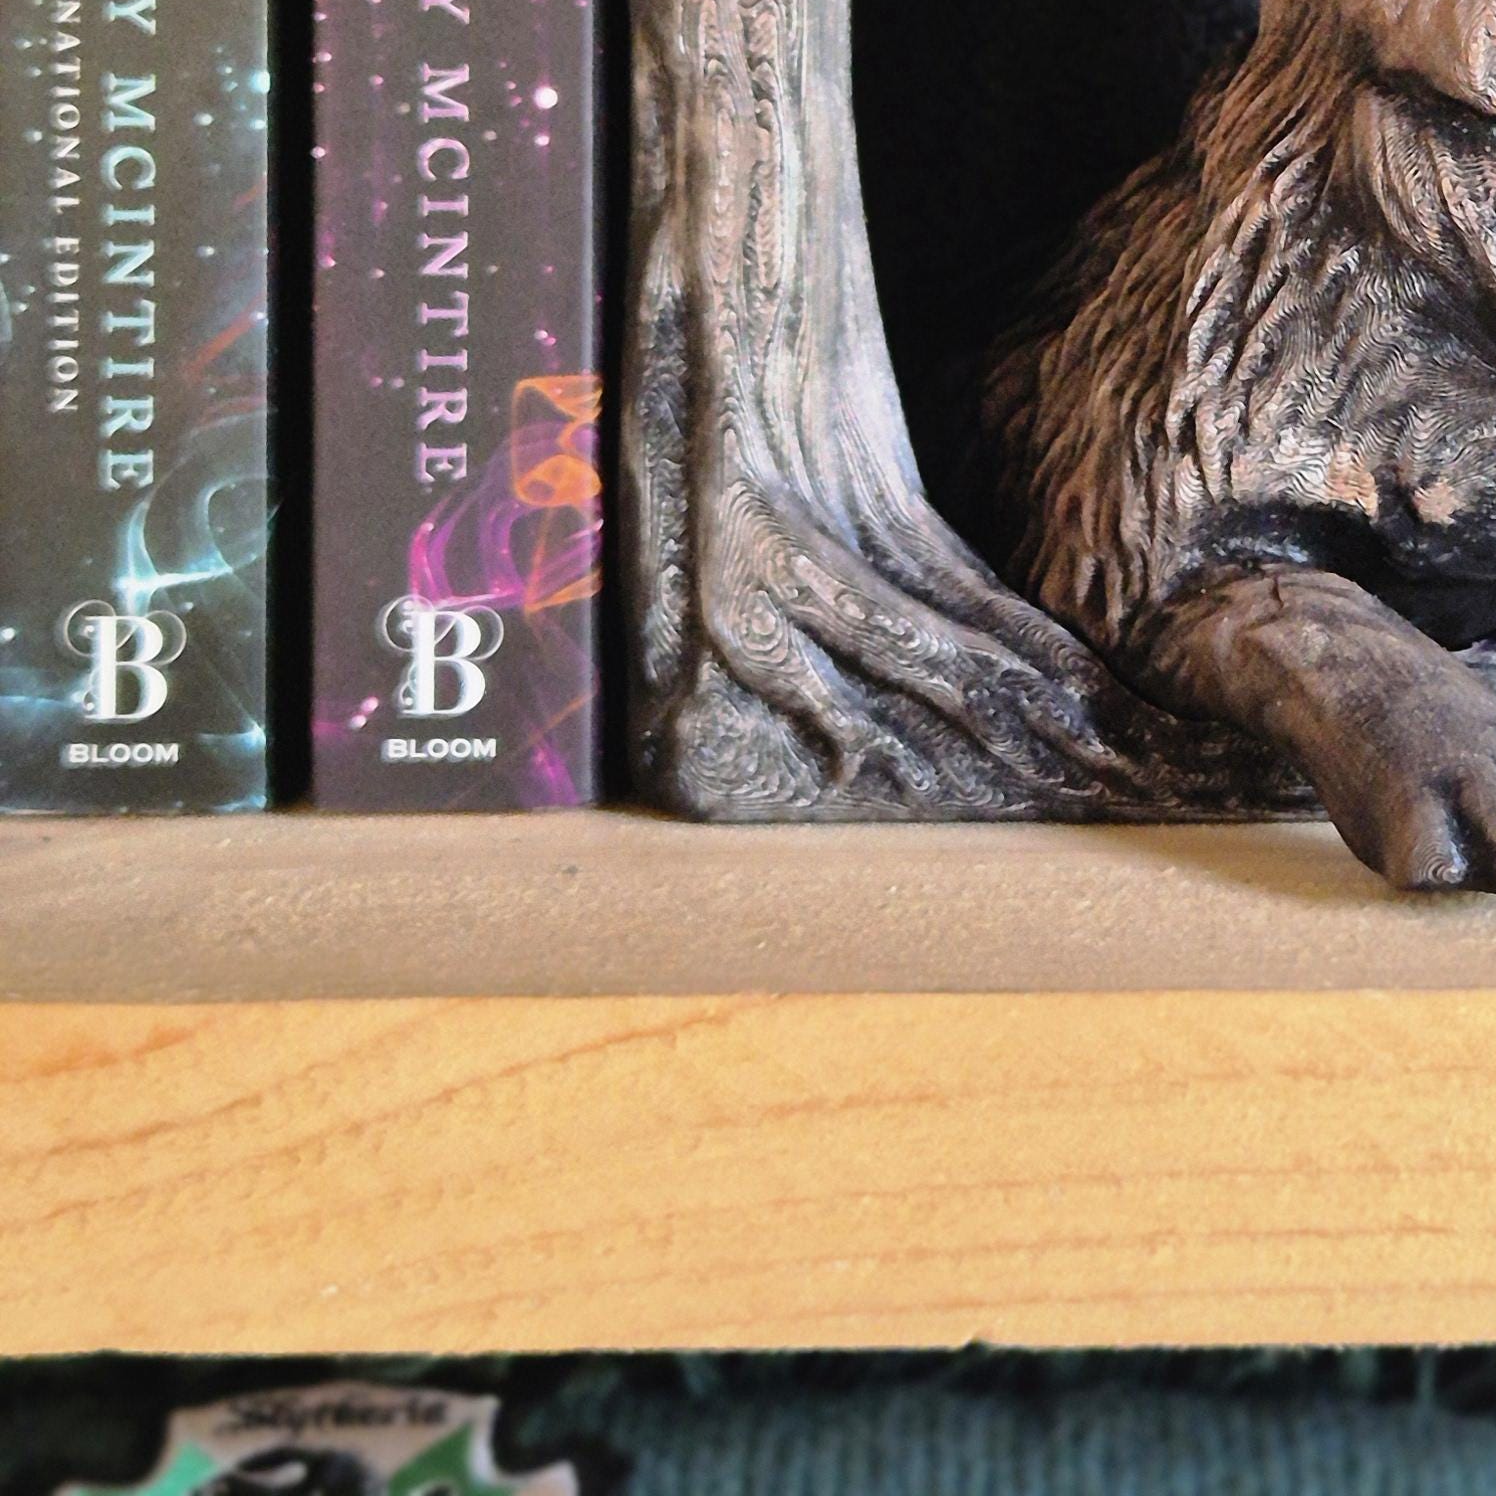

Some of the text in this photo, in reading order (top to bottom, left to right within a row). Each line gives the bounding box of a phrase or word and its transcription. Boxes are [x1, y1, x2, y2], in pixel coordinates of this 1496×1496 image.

[50, 236, 81, 414] EDITION
[100, 73, 156, 491] MCINTIRE
[416, 63, 470, 484] MCINTIRE
[64, 599, 187, 721] B
[383, 594, 504, 716] B
[64, 741, 180, 765] BLOOM
[384, 737, 498, 761] BLOOM
